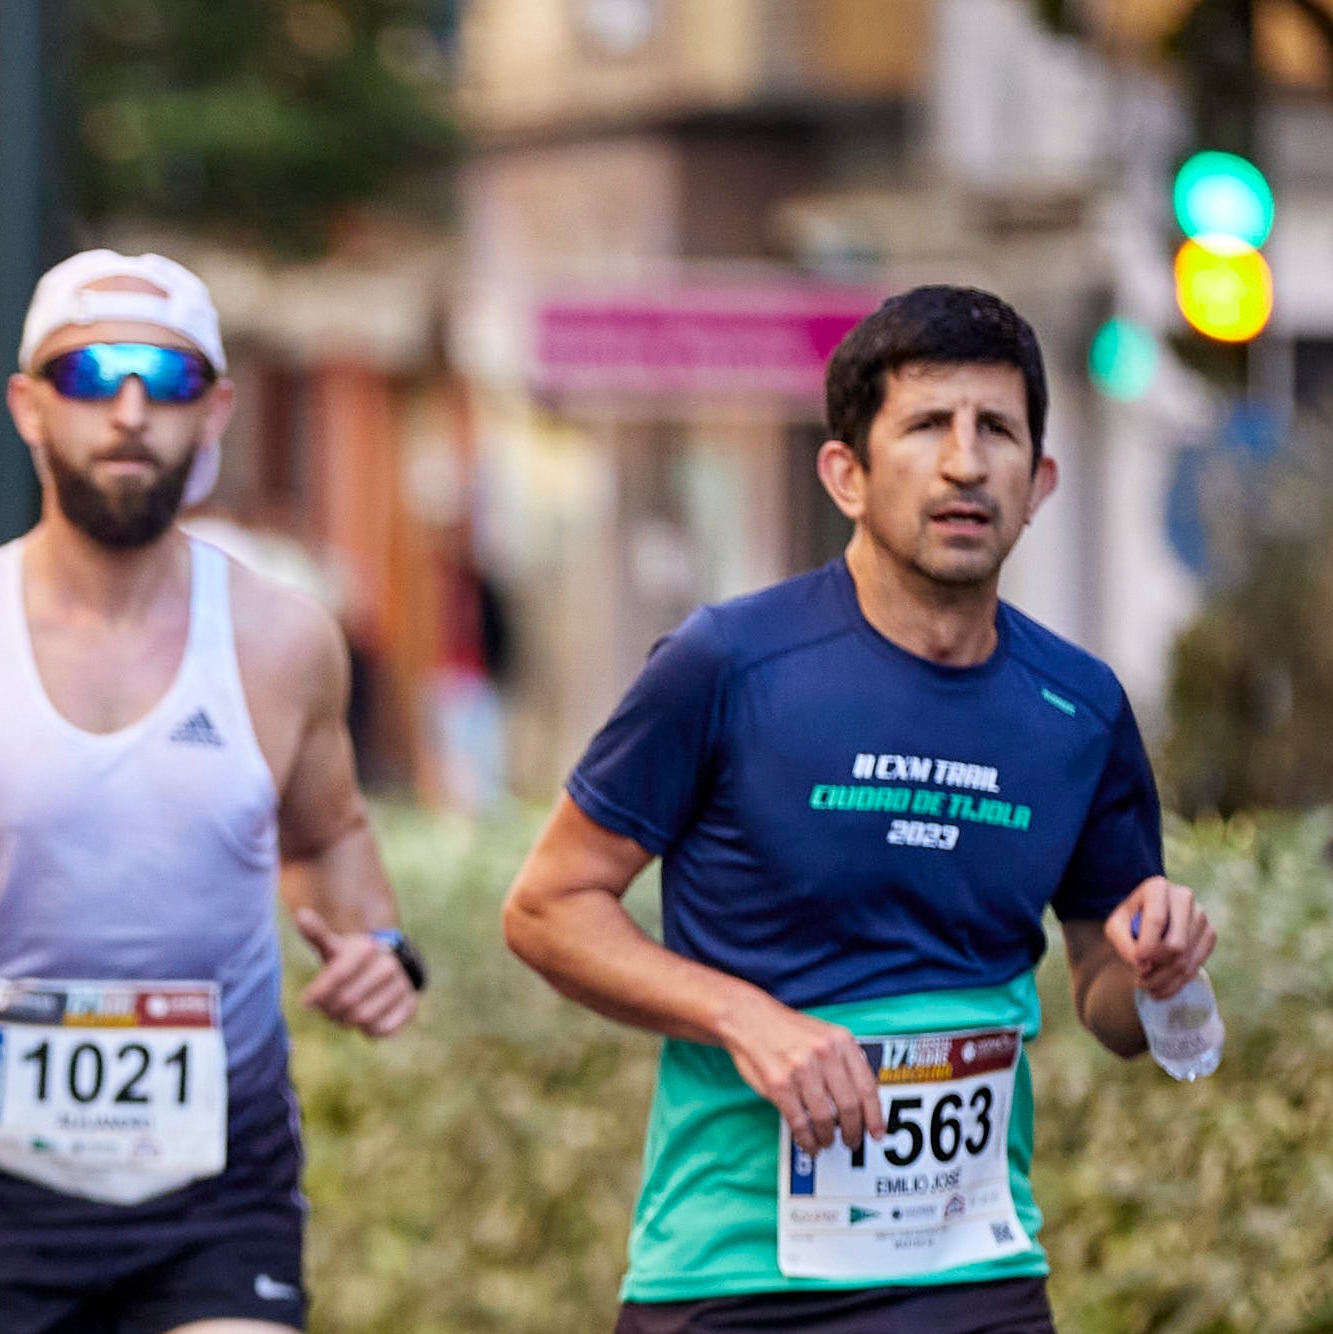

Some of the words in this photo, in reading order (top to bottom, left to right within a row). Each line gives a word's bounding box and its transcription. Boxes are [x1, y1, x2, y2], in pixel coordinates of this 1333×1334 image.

[933, 758, 1001, 794] TRAIL
[809, 784, 912, 813] CIUDAD
[911, 788, 947, 816] DE
[886, 818, 960, 851] 2023
[22, 1040, 189, 1105] 1021
